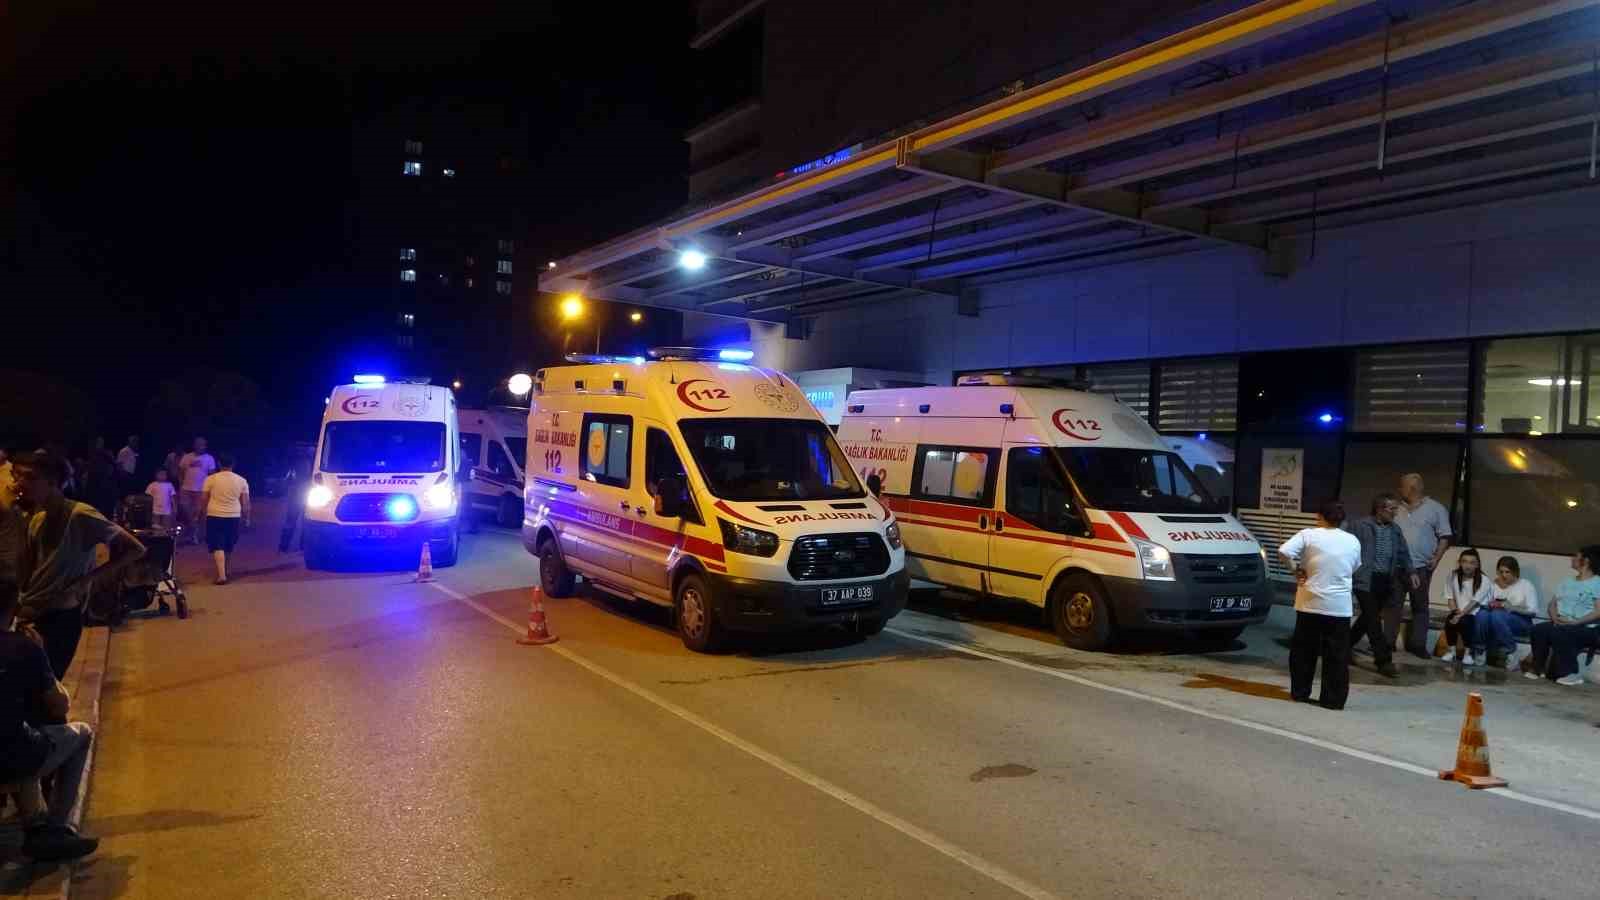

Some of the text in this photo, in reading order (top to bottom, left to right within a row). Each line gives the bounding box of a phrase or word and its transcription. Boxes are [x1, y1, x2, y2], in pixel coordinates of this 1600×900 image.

[688, 388, 731, 401] 112
[350, 400, 380, 409] 112
[1063, 419, 1103, 430] 112
[869, 446, 909, 462] BAKANLIĞI
[544, 449, 562, 473] 112
[827, 590, 837, 601] 37
[857, 587, 872, 598] 039
